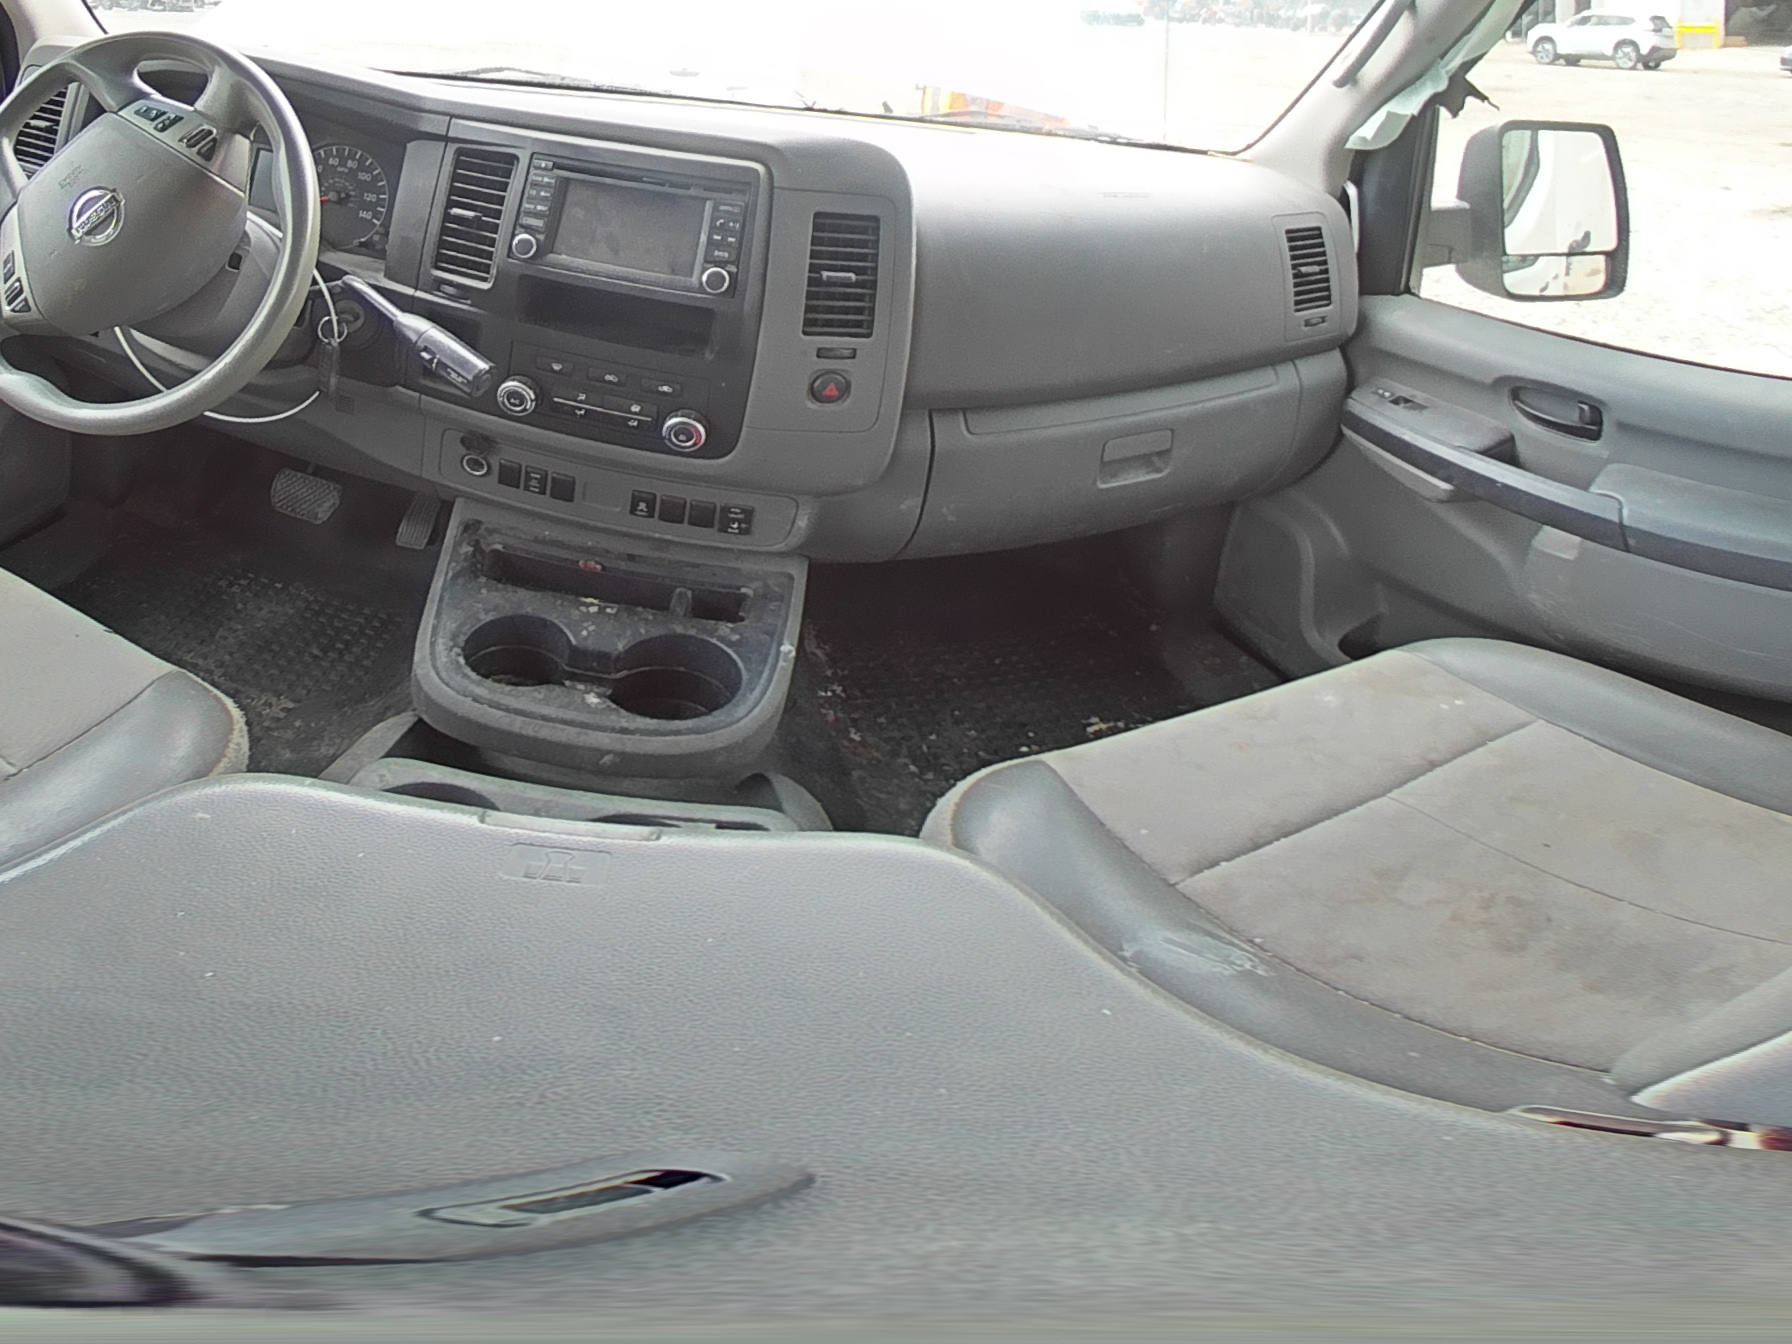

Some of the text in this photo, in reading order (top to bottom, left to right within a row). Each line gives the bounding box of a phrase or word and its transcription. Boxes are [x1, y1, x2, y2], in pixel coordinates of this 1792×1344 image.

[328, 157, 339, 166] 60
[346, 159, 358, 169] 80
[357, 171, 372, 181] 100
[363, 192, 377, 202] 120
[358, 209, 373, 220] 140
